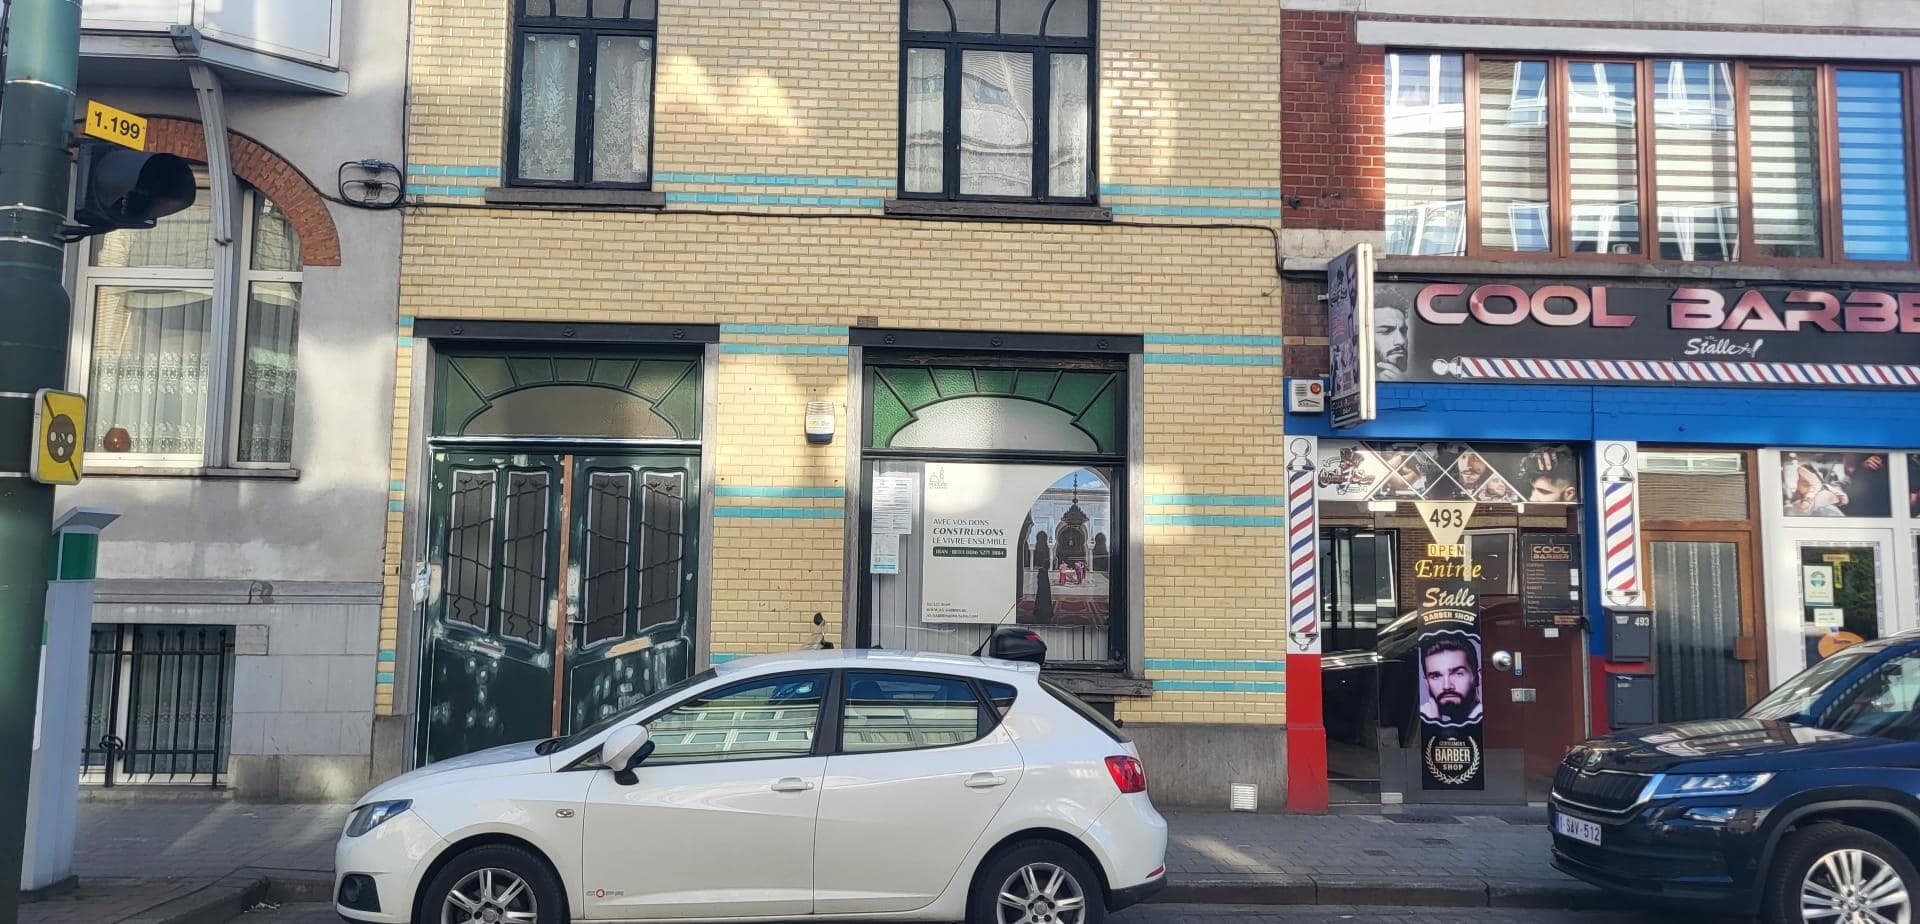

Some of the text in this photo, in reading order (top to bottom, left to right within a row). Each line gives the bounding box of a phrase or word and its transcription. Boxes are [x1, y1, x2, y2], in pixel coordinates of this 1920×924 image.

[95, 111, 140, 139] 1.199
[1416, 283, 1637, 327] COOL
[1684, 338, 1739, 355] Stalle
[1429, 508, 1463, 528] 493
[933, 527, 1005, 536] CONSTRUISONS
[1430, 545, 1465, 556] OPEN
[1533, 546, 1569, 554] COOL
[1423, 587, 1476, 608] Stalle
[1423, 612, 1475, 622] BARBER SHOP
[1634, 616, 1650, 627] 493
[1435, 748, 1470, 762] BARBER
